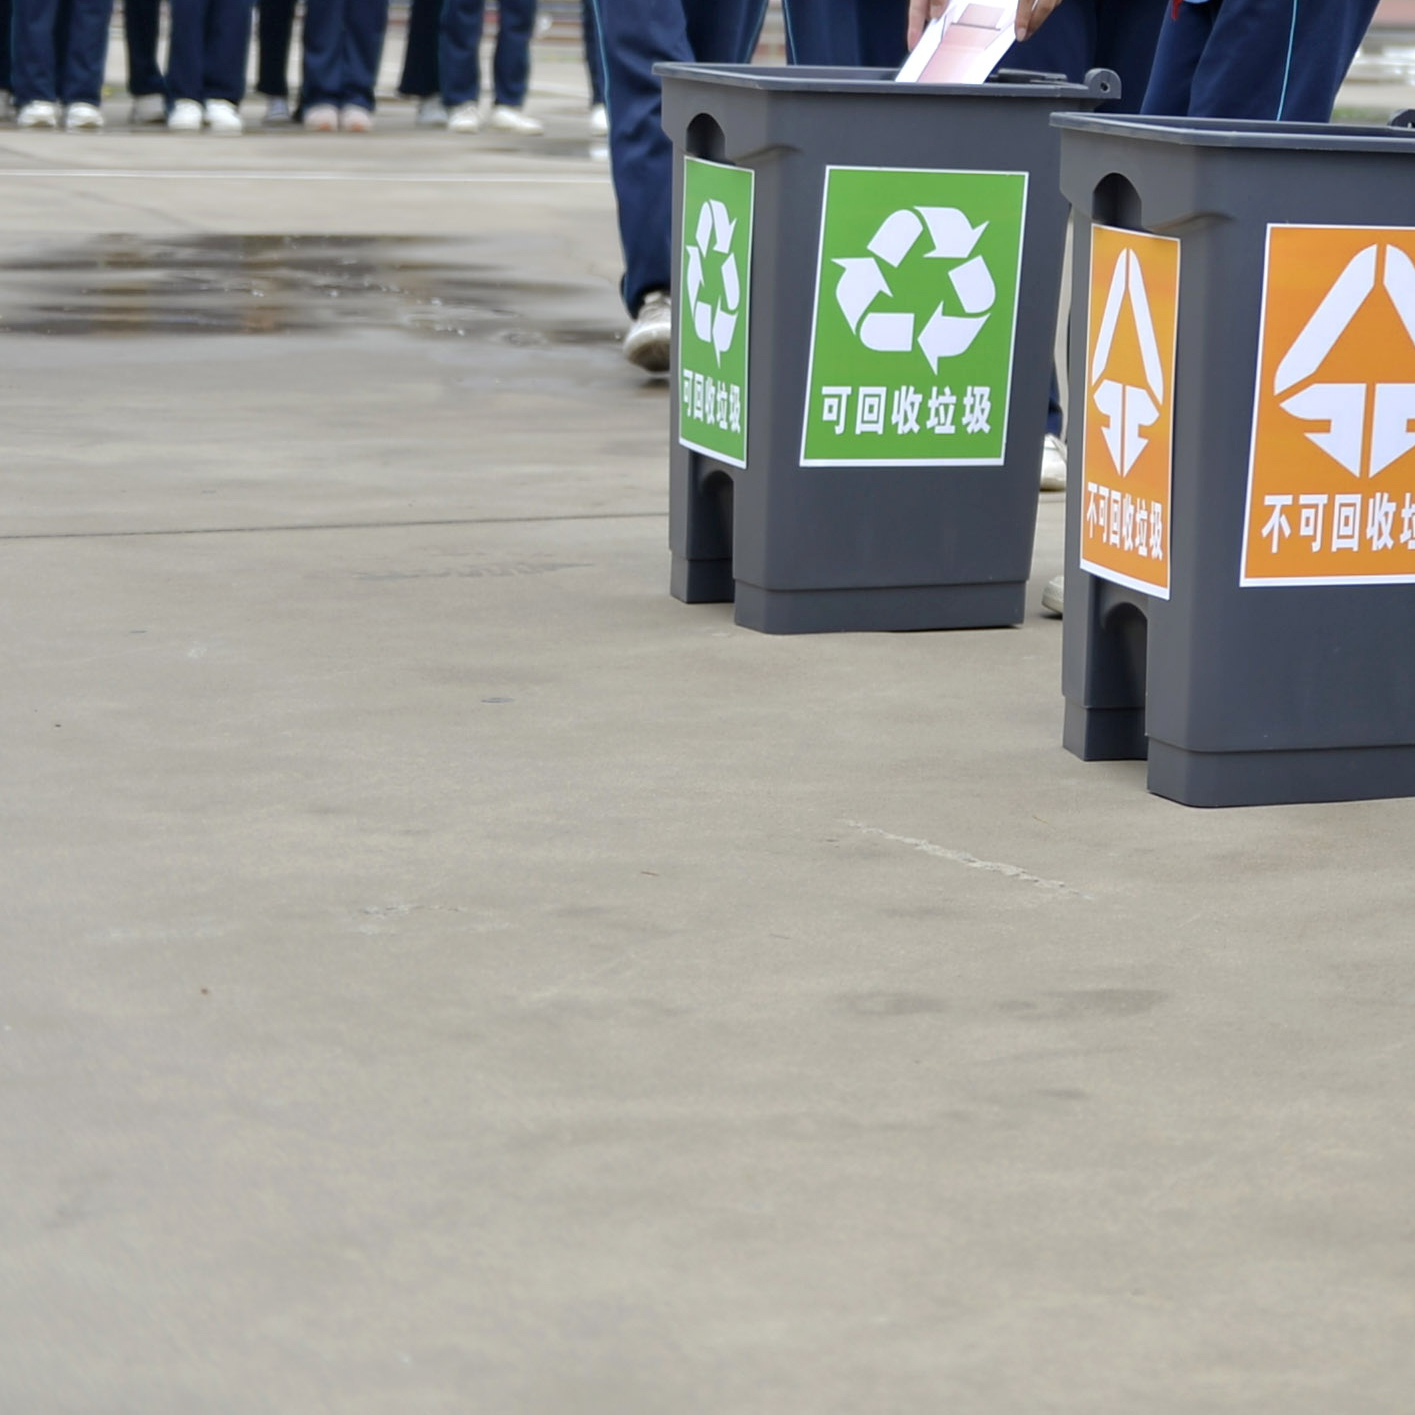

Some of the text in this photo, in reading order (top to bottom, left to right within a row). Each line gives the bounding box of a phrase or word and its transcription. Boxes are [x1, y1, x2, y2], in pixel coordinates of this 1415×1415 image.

[683, 368, 741, 433] 可回收垃圾
[821, 385, 991, 435] 可回收垃圾
[1086, 481, 1163, 560] 不可回收垃圾
